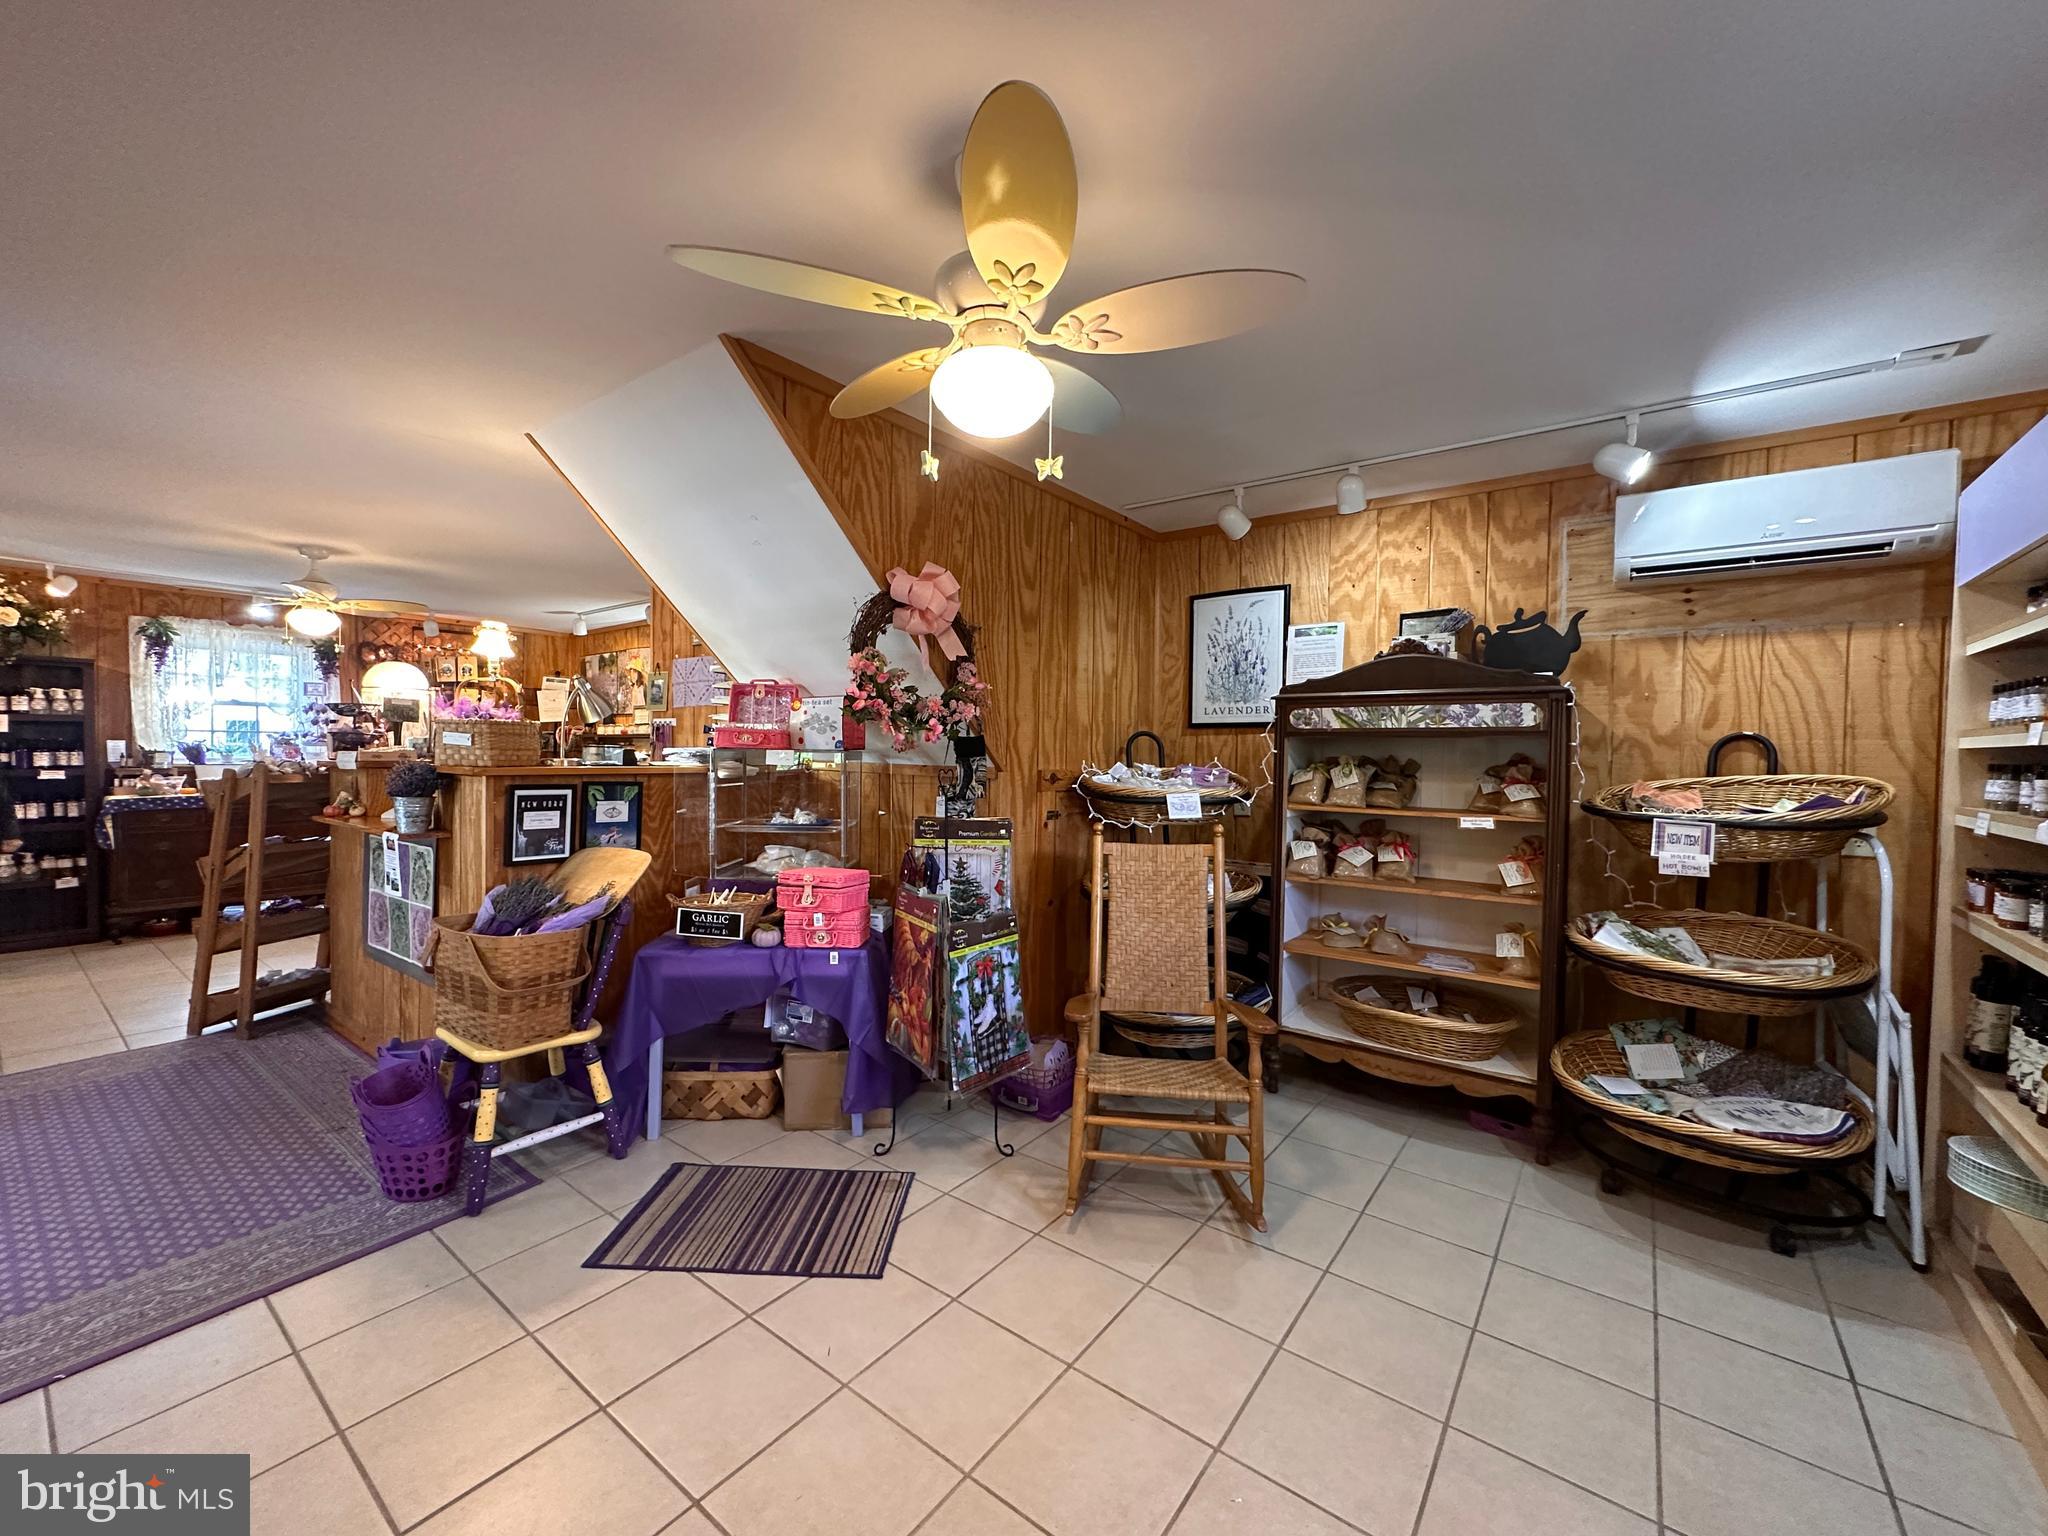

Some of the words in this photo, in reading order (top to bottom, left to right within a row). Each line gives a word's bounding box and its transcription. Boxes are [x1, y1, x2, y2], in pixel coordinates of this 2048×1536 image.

[1204, 706, 1270, 716] LAVENDER
[543, 800, 563, 808] YORK
[1667, 833, 1683, 844] NEW
[1683, 834, 1700, 846] ITEM
[1681, 864, 1708, 873] BOWLS
[692, 912, 729, 924] GARLIC
